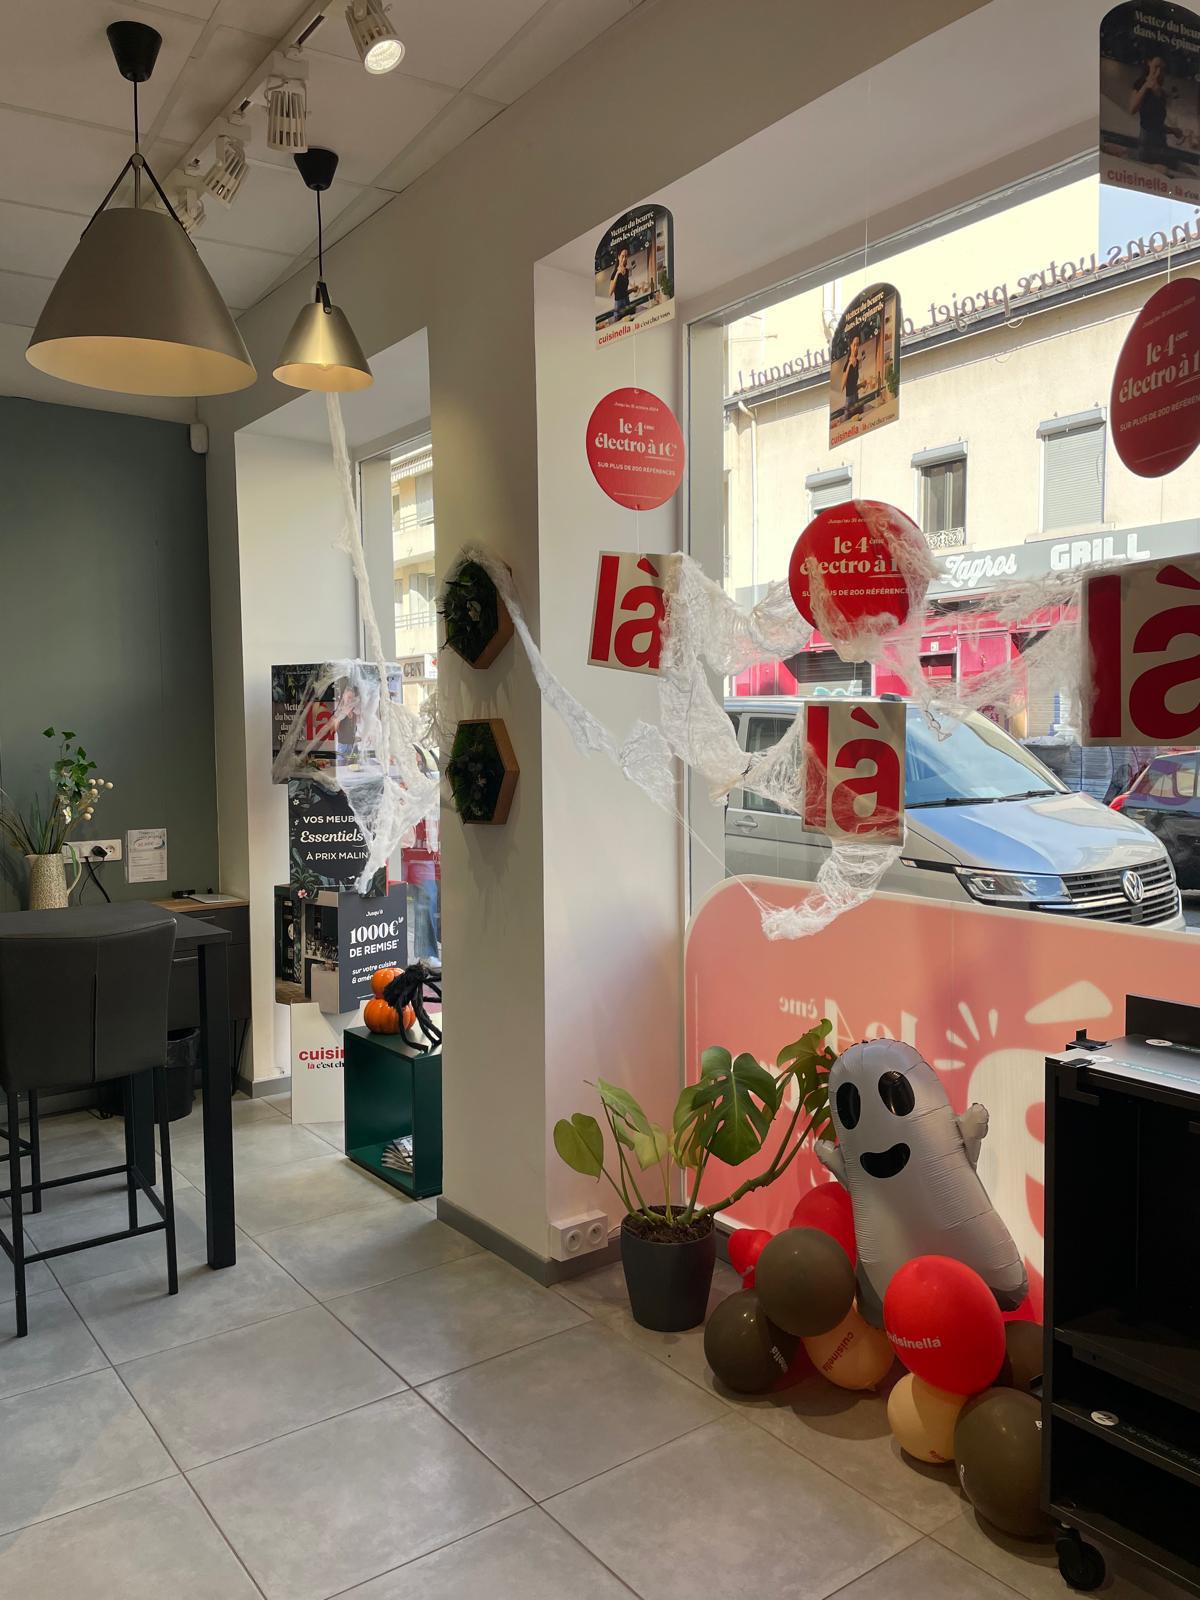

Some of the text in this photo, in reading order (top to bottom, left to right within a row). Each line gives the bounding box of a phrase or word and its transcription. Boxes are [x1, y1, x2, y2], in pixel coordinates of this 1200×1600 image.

[1107, 169, 1168, 193] cuisinella
[598, 324, 631, 345] cuisinella
[1145, 342, 1161, 367] le
[1119, 362, 1176, 404] électro
[1179, 353, 1190, 378] à
[619, 418, 632, 434] le
[595, 432, 646, 454] électro
[647, 439, 657, 455] à
[834, 536, 852, 554] le
[1050, 533, 1151, 571] GRILL
[873, 554, 886, 572] à
[849, 588, 865, 596] 200
[591, 555, 665, 669] là
[403, 662, 425, 677] CEN
[805, 705, 900, 834] là
[303, 815, 355, 824] VOS MEUB
[300, 828, 364, 843] Essentiels
[306, 851, 314, 861] À
[315, 852, 337, 861] PRIX
[349, 946, 363, 958] DE
[352, 960, 397, 976] sur votre cuisine
[299, 1046, 344, 1061] cuisi
[316, 1061, 334, 1069] c'est
[822, 1331, 854, 1372] cuisinella
